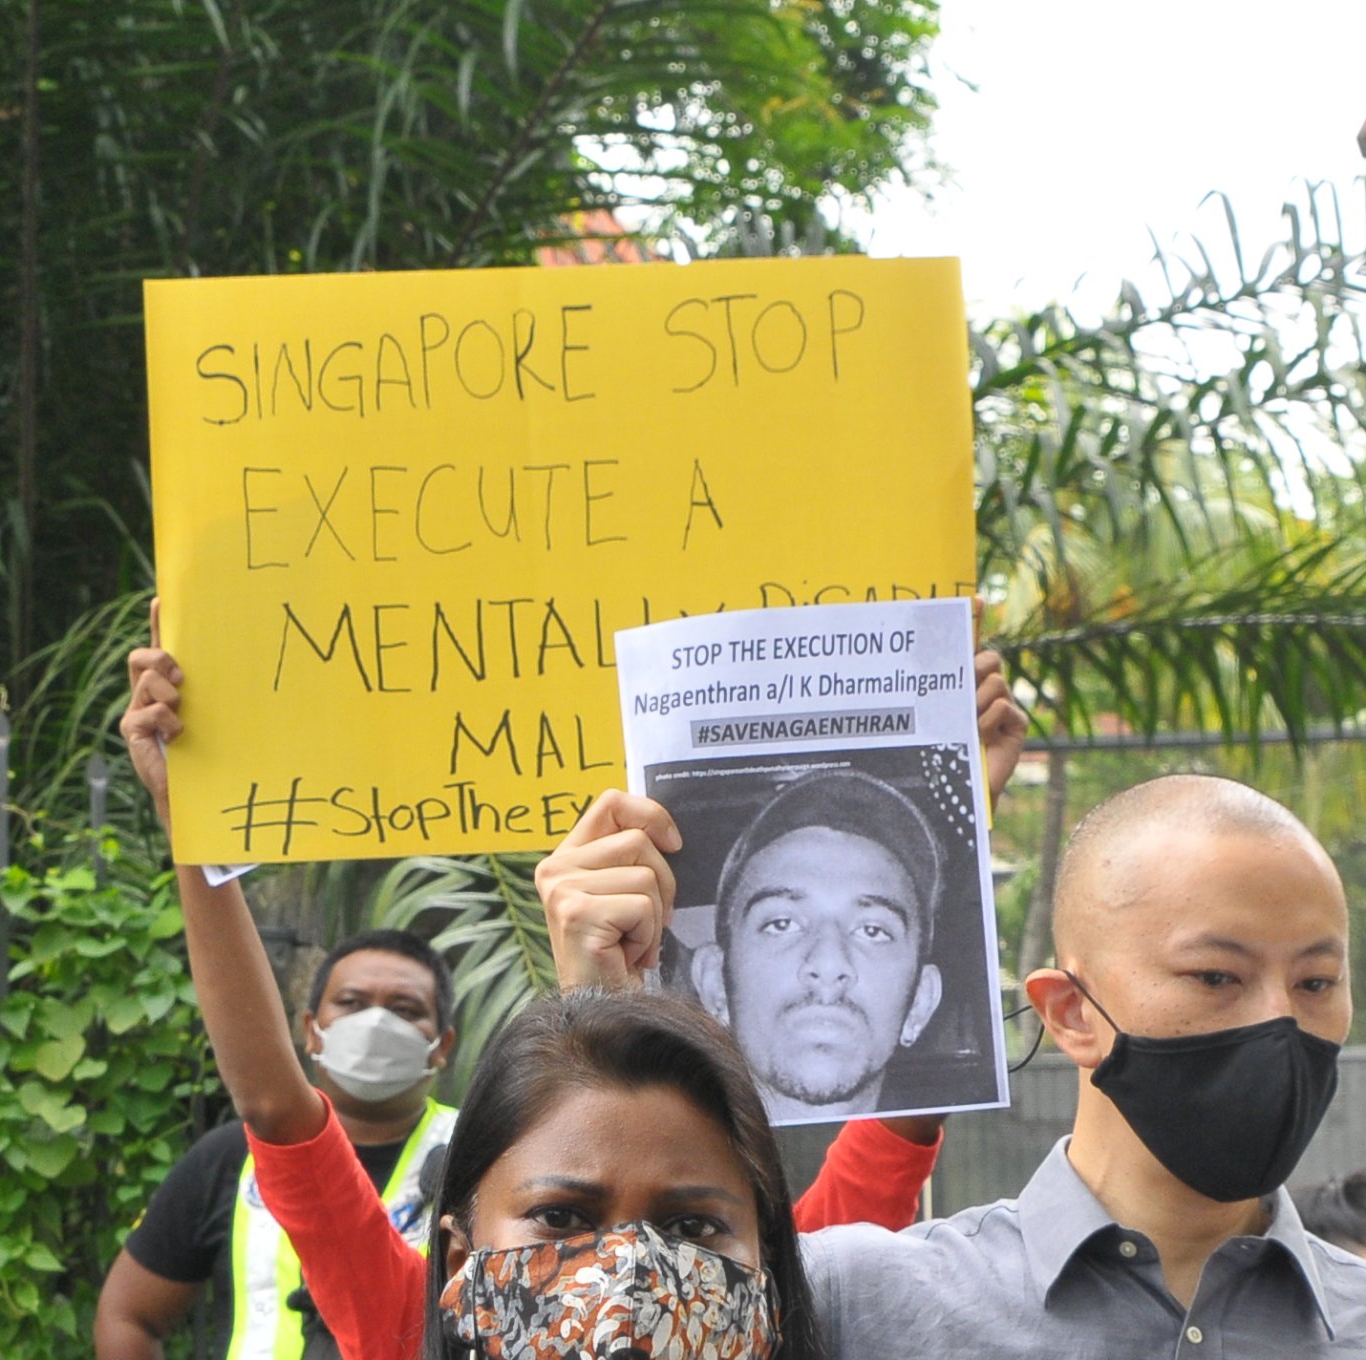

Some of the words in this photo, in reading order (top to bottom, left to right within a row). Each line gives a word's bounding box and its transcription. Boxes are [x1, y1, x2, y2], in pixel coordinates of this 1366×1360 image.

[195, 305, 596, 426] SINGAPORE
[663, 289, 866, 394] STOP
[244, 458, 628, 570] EXECUTE
[682, 458, 724, 552] A
[671, 642, 722, 669] STOP
[728, 638, 766, 663] THE
[773, 632, 883, 660] EXECUTION
[889, 630, 915, 653] OF
[634, 679, 760, 715] Nagaenthran
[801, 674, 812, 698] K
[818, 666, 963, 698] Dharmalingam!
[450, 710, 627, 777] MAL
[698, 713, 910, 744] #SAVENAGAENTHRAN
